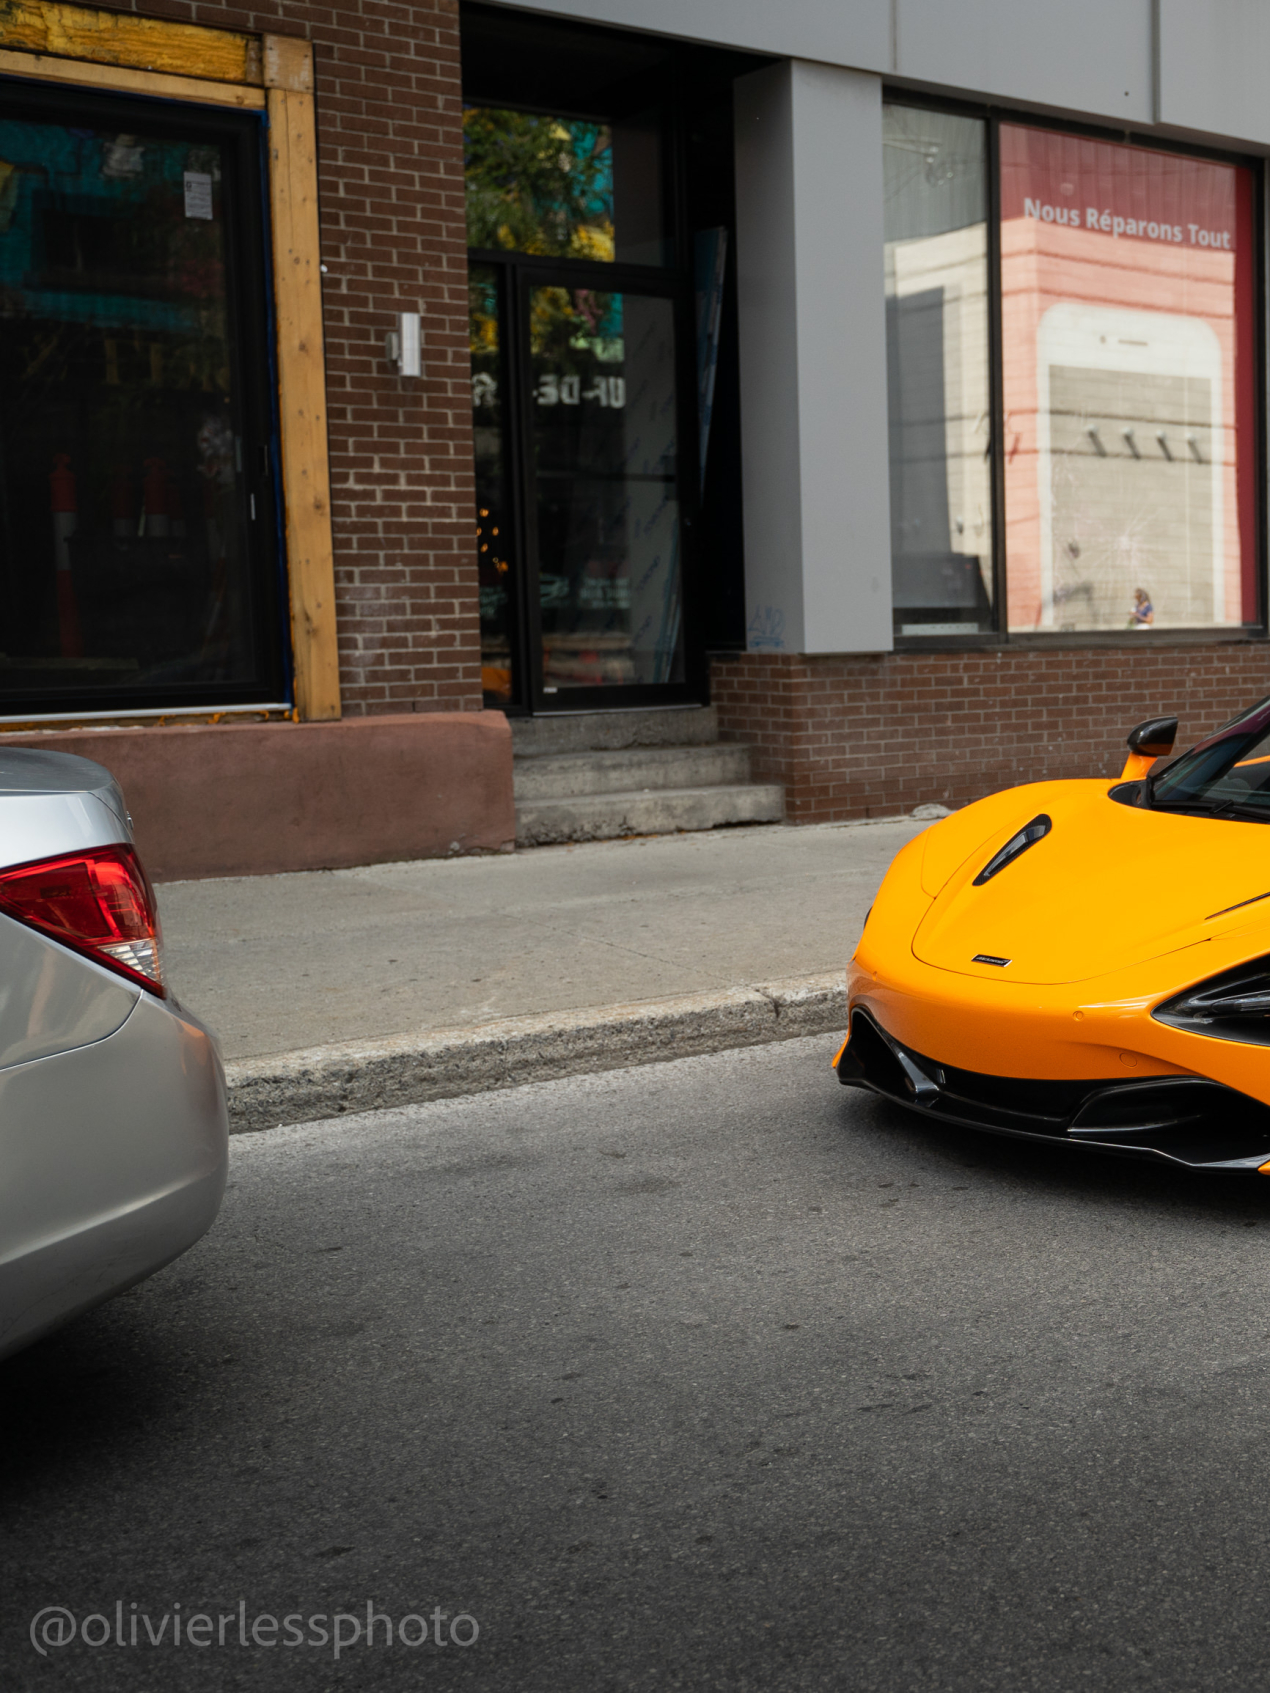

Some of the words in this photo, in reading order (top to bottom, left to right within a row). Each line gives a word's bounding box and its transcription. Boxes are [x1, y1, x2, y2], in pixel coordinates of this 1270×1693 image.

[1024, 197, 1080, 226] Nous
[1086, 207, 1183, 242] Réparons
[1188, 223, 1231, 249] Tout
